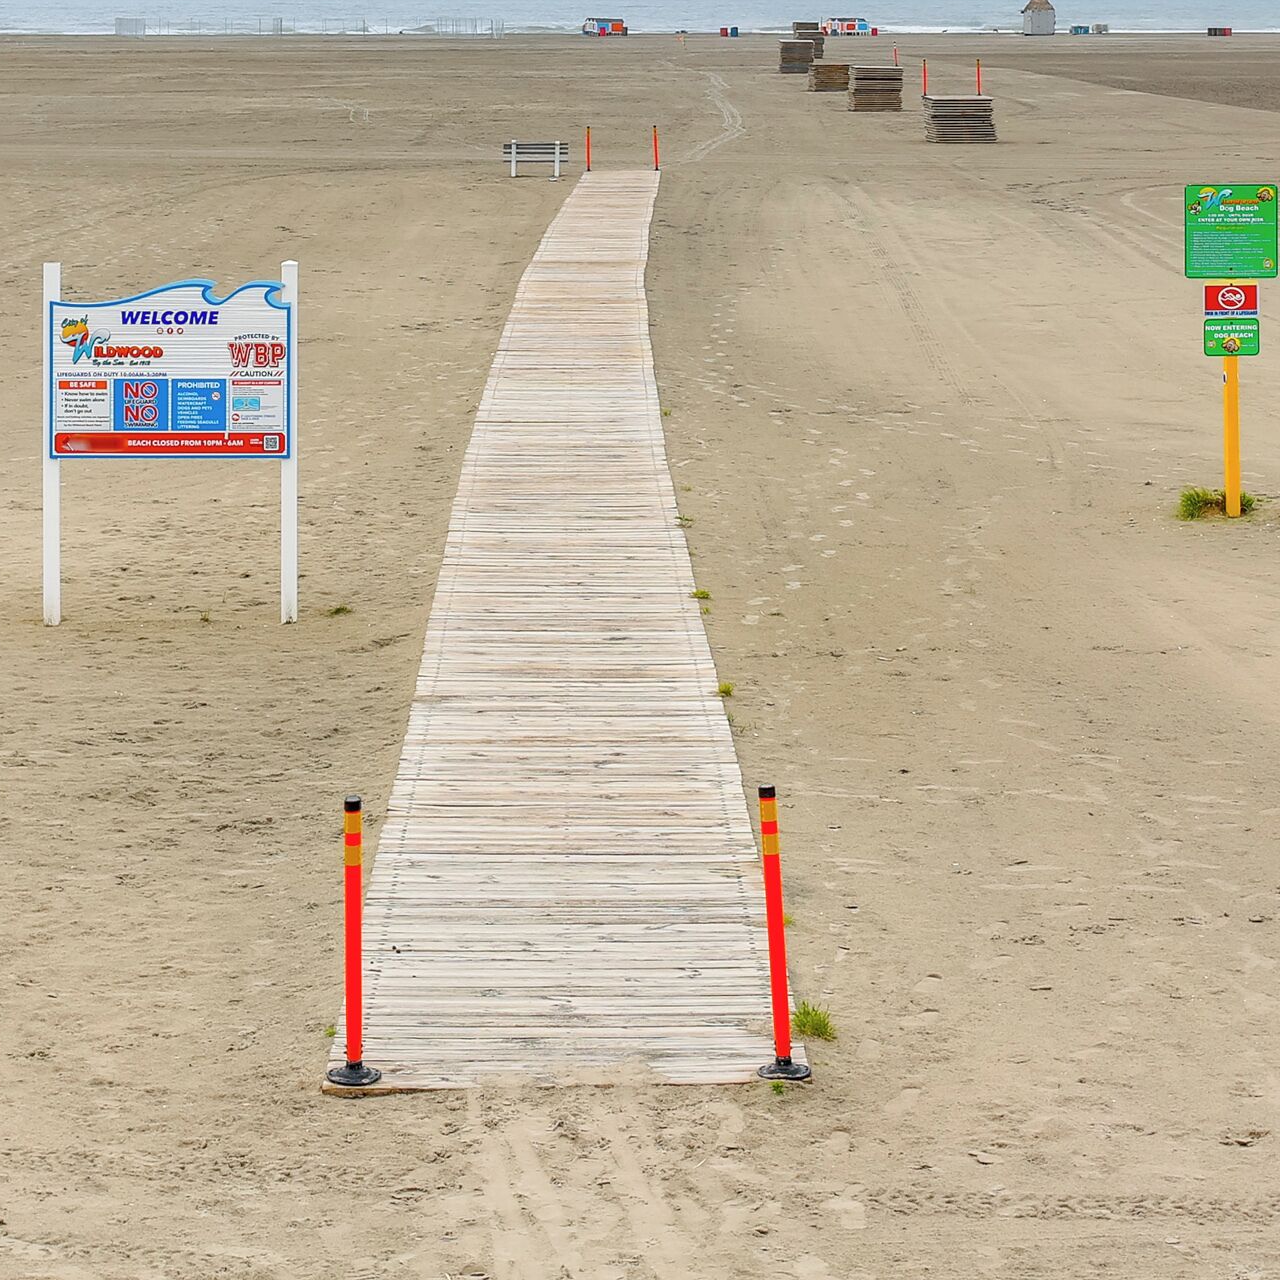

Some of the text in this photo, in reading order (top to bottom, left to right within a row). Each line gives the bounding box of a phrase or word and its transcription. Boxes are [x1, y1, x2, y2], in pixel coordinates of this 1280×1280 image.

[61, 314, 88, 328] City of
[121, 311, 219, 325] WELCOME
[234, 333, 270, 341] PROTECTED
[228, 342, 286, 368] WBP
[92, 359, 101, 367] By
[124, 382, 158, 399] NO
[124, 405, 158, 422] NO
